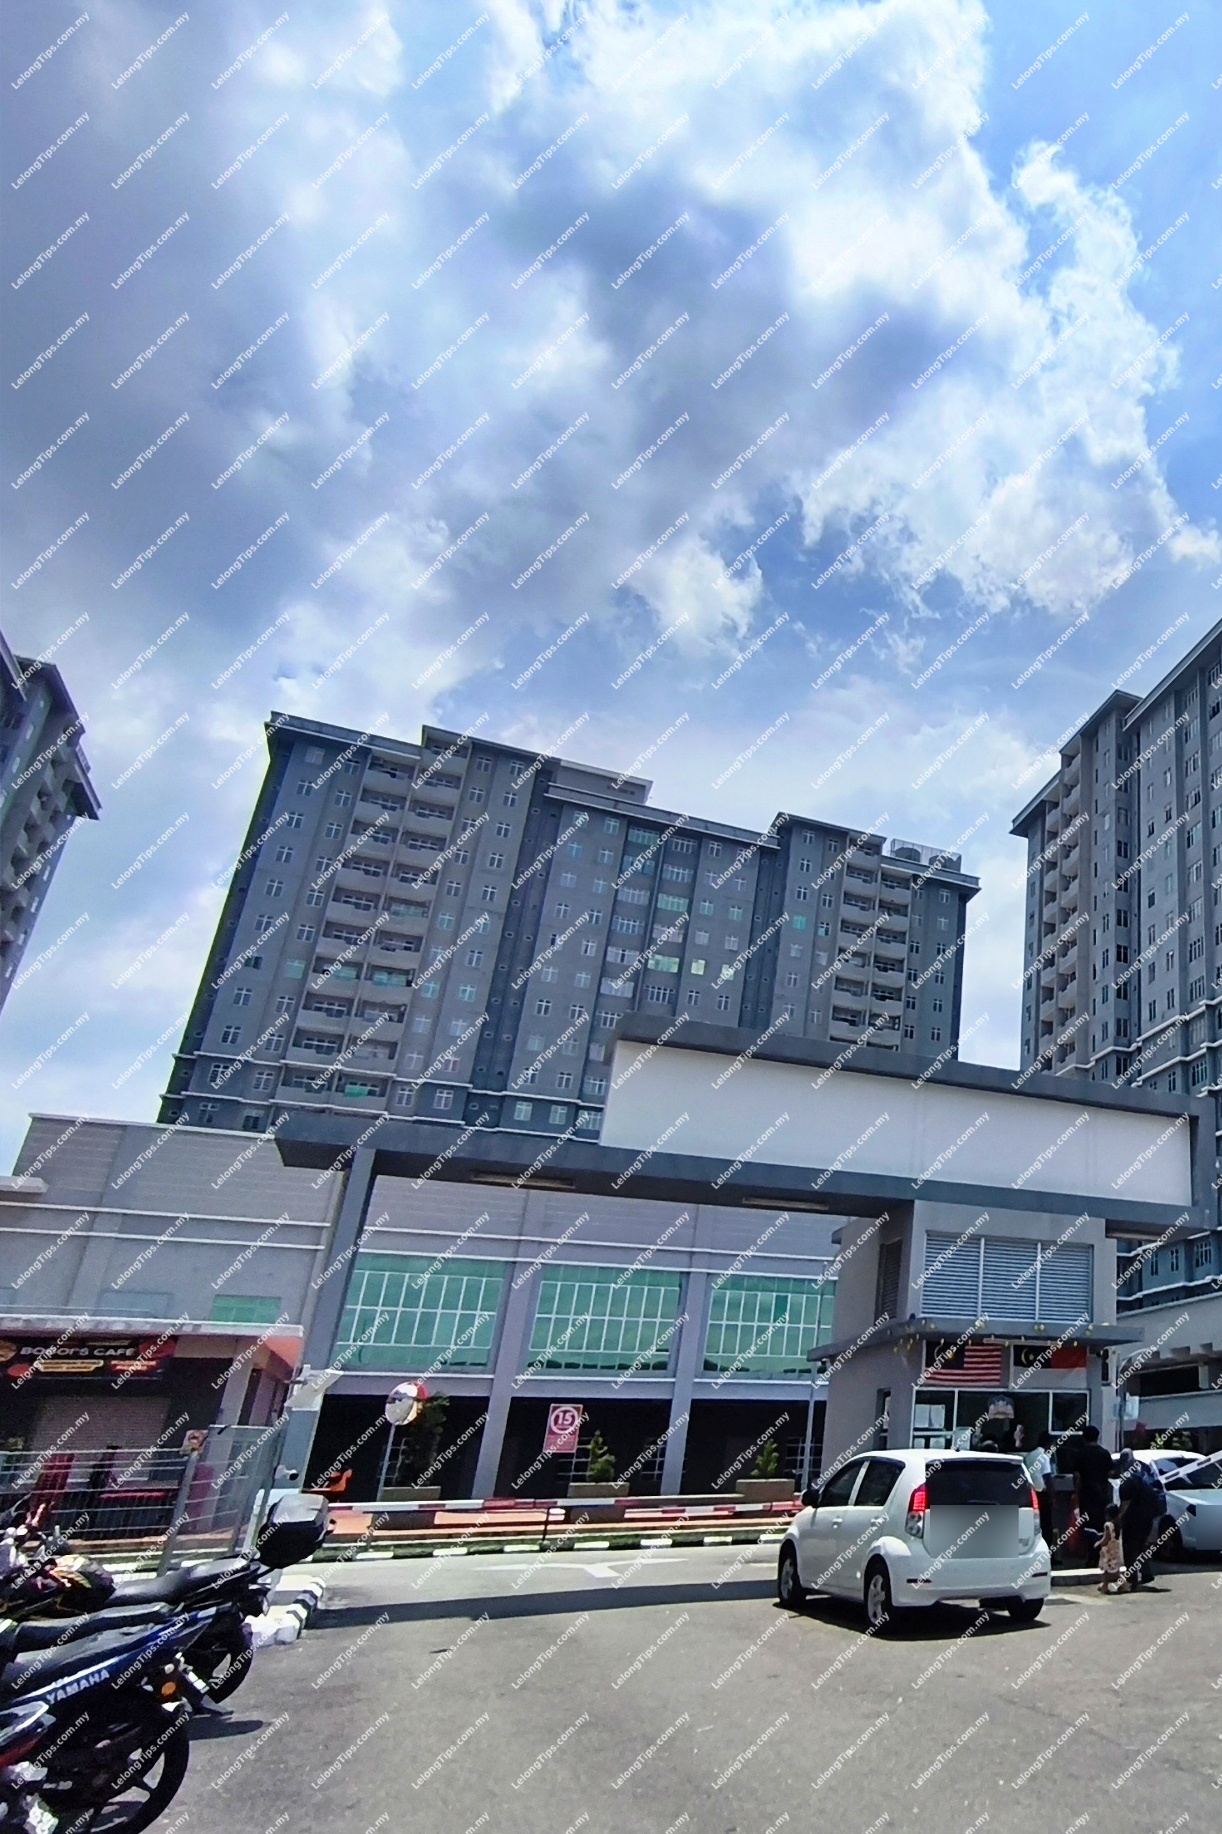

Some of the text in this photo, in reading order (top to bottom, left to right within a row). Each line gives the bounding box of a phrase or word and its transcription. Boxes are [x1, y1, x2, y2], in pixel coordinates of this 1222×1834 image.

[94, 1348, 135, 1356] CAFE
[558, 1412, 573, 1425] 15
[46, 1669, 110, 1704] YAMAHA
